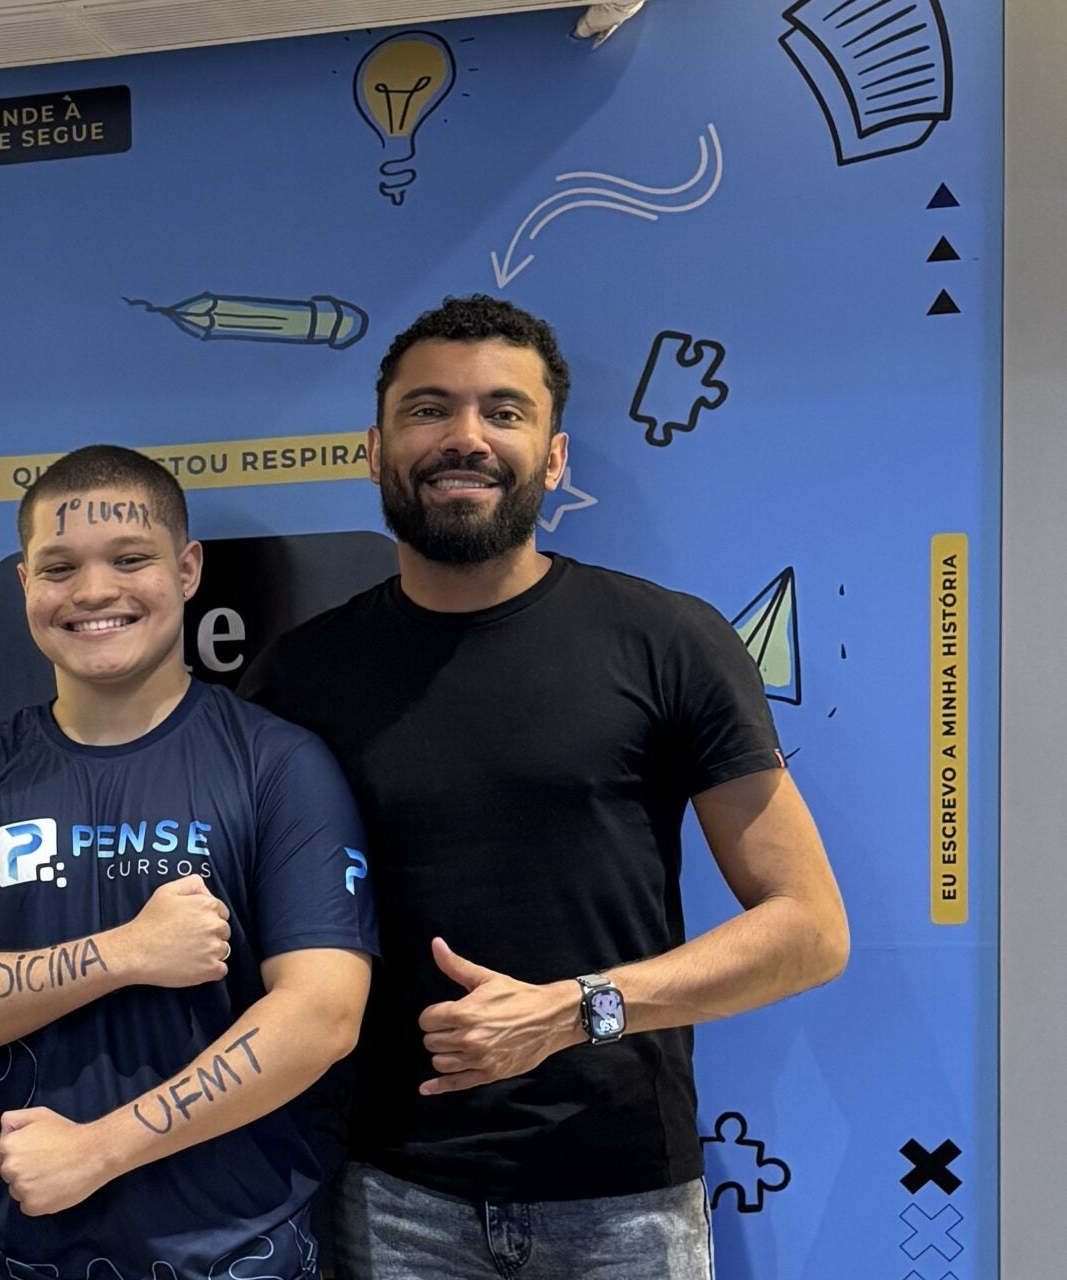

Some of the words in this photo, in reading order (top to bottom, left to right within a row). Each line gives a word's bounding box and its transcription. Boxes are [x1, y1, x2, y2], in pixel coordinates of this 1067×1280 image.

[62, 94, 82, 120] À
[21, 122, 105, 149] SEGUE
[157, 453, 228, 477] TOU
[86, 500, 152, 531] LUGAR
[938, 553, 958, 656] HISTÓRIA
[942, 664, 957, 737] MINHA
[942, 744, 957, 759] A
[942, 766, 957, 865] ESCREVO
[71, 820, 212, 859] PENSE
[107, 859, 211, 880] CURSOS
[942, 873, 957, 901] EU
[133, 1026, 262, 1135] UFMT
